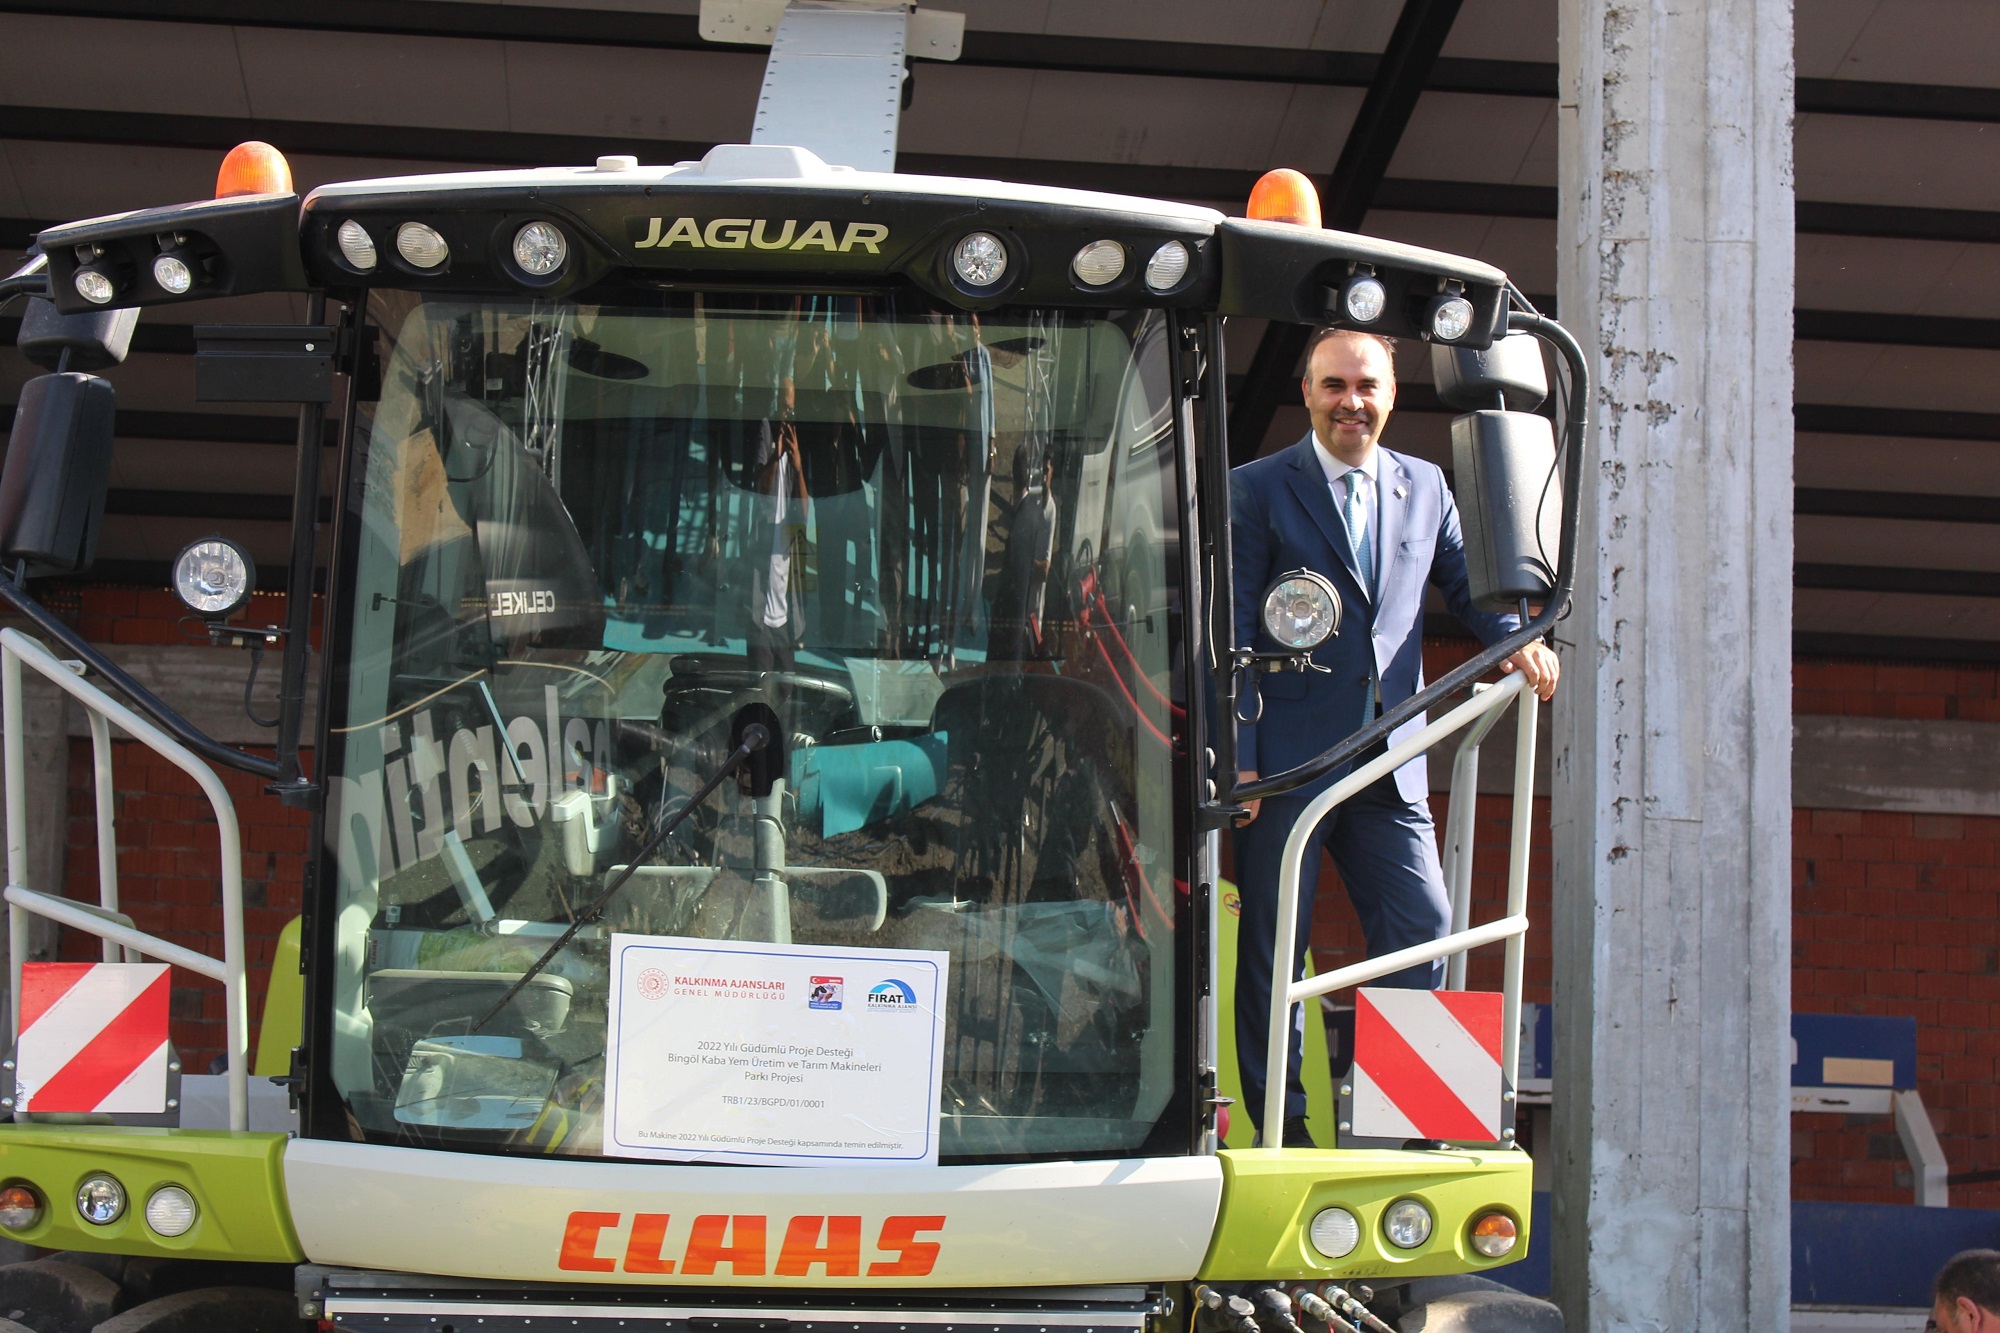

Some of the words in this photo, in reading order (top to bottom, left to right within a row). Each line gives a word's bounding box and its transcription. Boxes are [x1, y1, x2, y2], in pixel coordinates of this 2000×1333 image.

[635, 217, 889, 254] JAGUAR
[674, 976, 728, 988] KALKINMA
[730, 980, 785, 991] AJANSLARI
[674, 988, 708, 997] GENEL
[714, 989, 785, 1001] MÜDÜRLÜĞÜ
[867, 993, 904, 1004] FIRAT
[697, 1041, 722, 1051] 2022
[724, 1042, 738, 1052] Yılı
[740, 1043, 786, 1055] Güdümlü
[789, 1045, 814, 1057] Proje
[816, 1046, 854, 1059] Desteği
[668, 1053, 699, 1065] Bingöl
[702, 1055, 726, 1065] Kaba
[729, 1056, 749, 1067] Yem
[752, 1056, 785, 1068] Üretim
[787, 1061, 799, 1069] ve
[801, 1061, 828, 1070] Tarım
[830, 1061, 881, 1072] Makineleri
[744, 1071, 768, 1081] Parkı
[771, 1073, 803, 1085] Projesi
[722, 1095, 825, 1108] TRB1/23/BGPD/01/0001
[638, 1130, 648, 1138] Bu
[650, 1131, 677, 1140] Makine
[678, 1133, 696, 1141] 2022
[698, 1134, 709, 1142] Yılı
[711, 1135, 745, 1143] Güdümlü
[747, 1136, 766, 1146] Proje
[767, 1138, 796, 1147] Desteği
[797, 1139, 842, 1148] kapsamında
[867, 1141, 904, 1150] edilmiştir.
[559, 1211, 946, 1277] CLAAS
